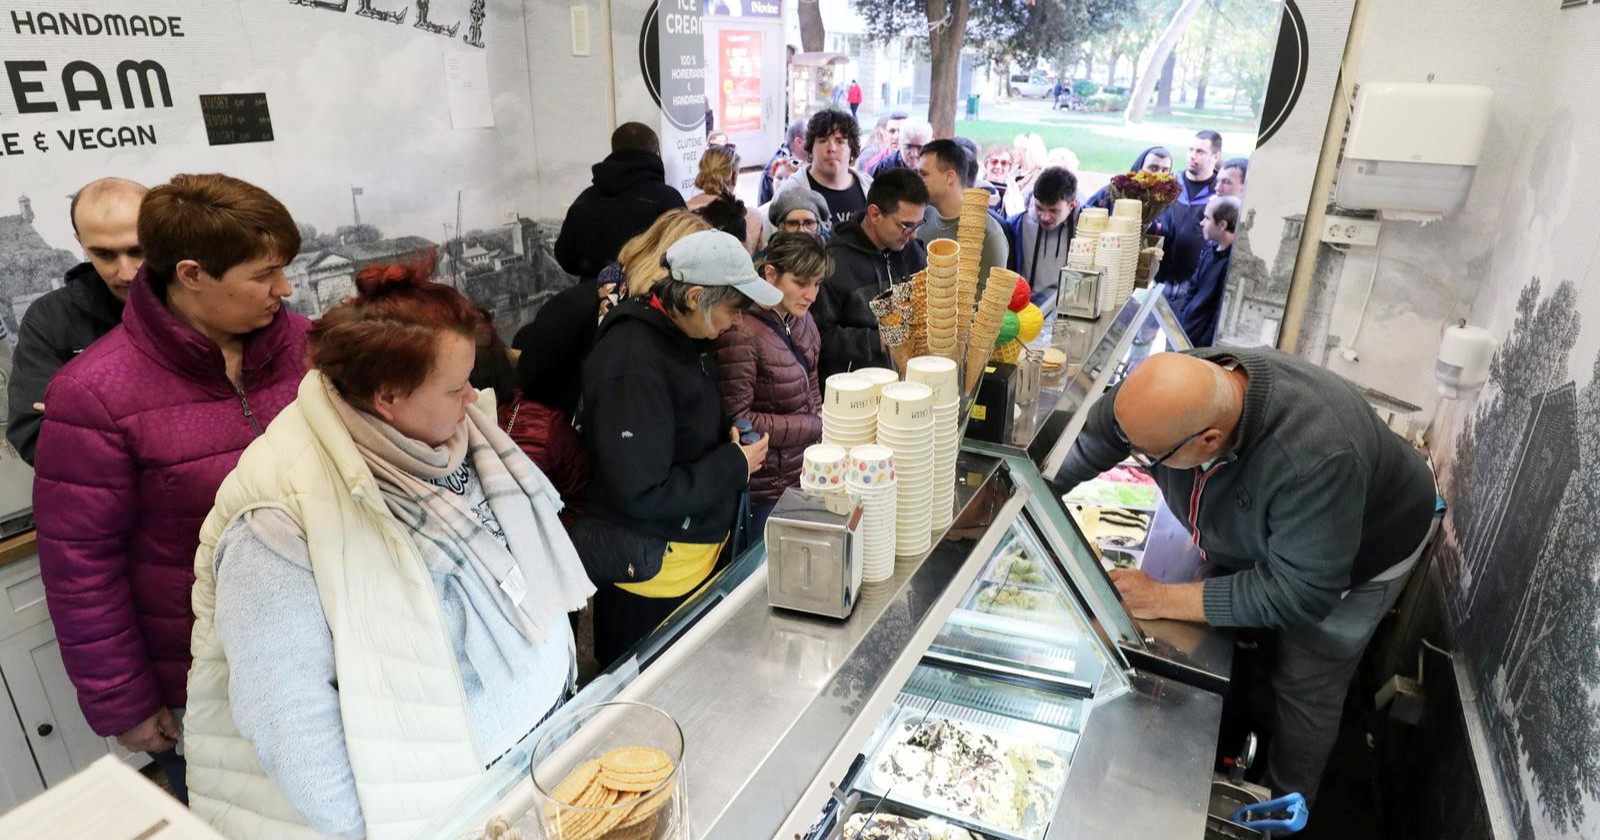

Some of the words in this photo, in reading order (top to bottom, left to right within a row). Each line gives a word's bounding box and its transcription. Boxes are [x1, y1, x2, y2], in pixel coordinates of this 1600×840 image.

[677, 0, 697, 11] ICE
[10, 10, 185, 37] HANDMADE
[0, 59, 174, 115] EAM
[0, 132, 24, 156] E
[56, 124, 157, 151] VEGAN
